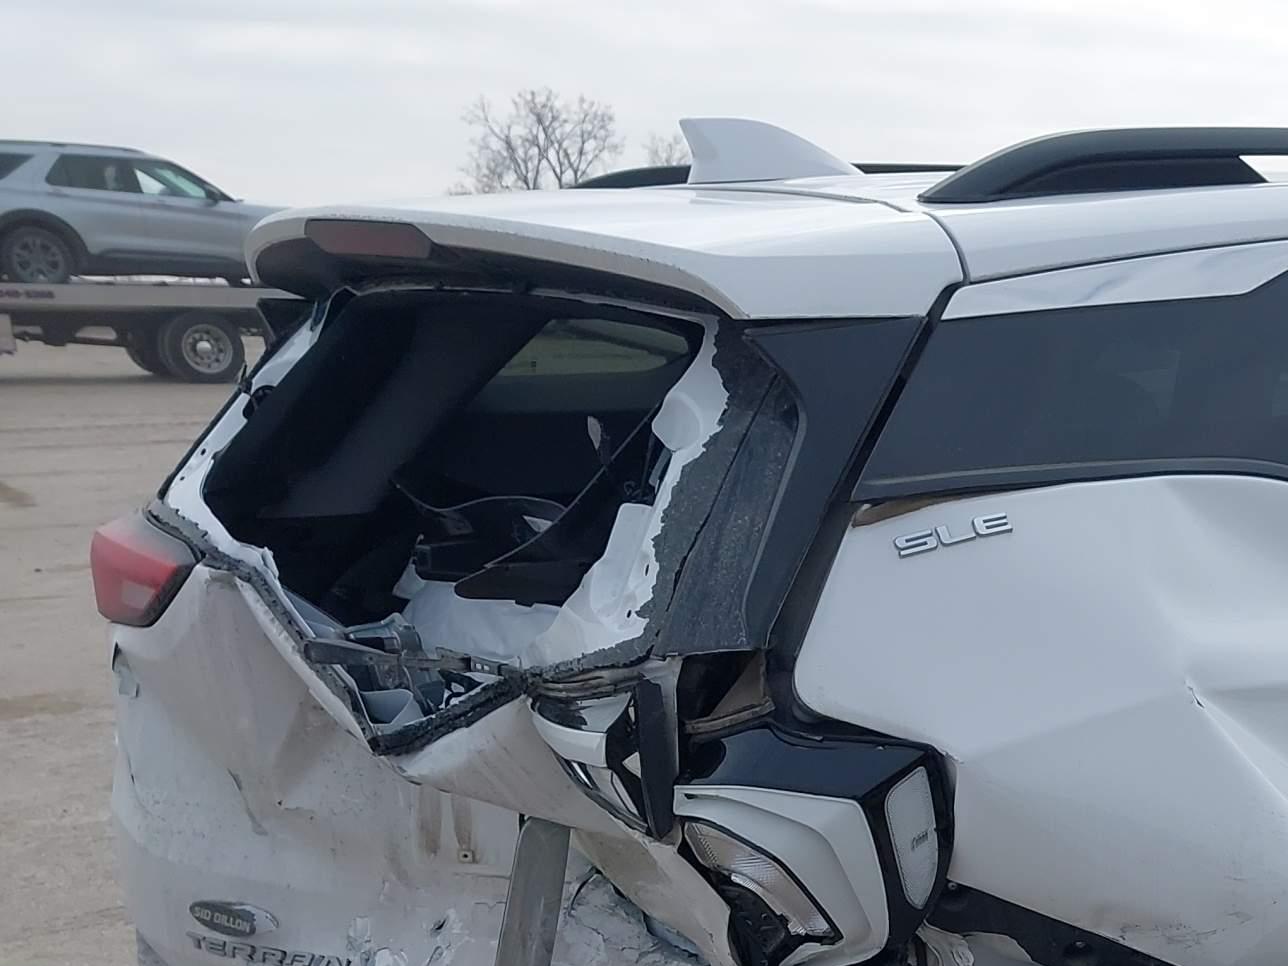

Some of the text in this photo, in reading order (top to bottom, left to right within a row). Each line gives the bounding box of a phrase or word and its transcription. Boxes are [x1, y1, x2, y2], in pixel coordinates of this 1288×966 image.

[893, 512, 1014, 559] SLE
[193, 905, 251, 934] SID DILLON
